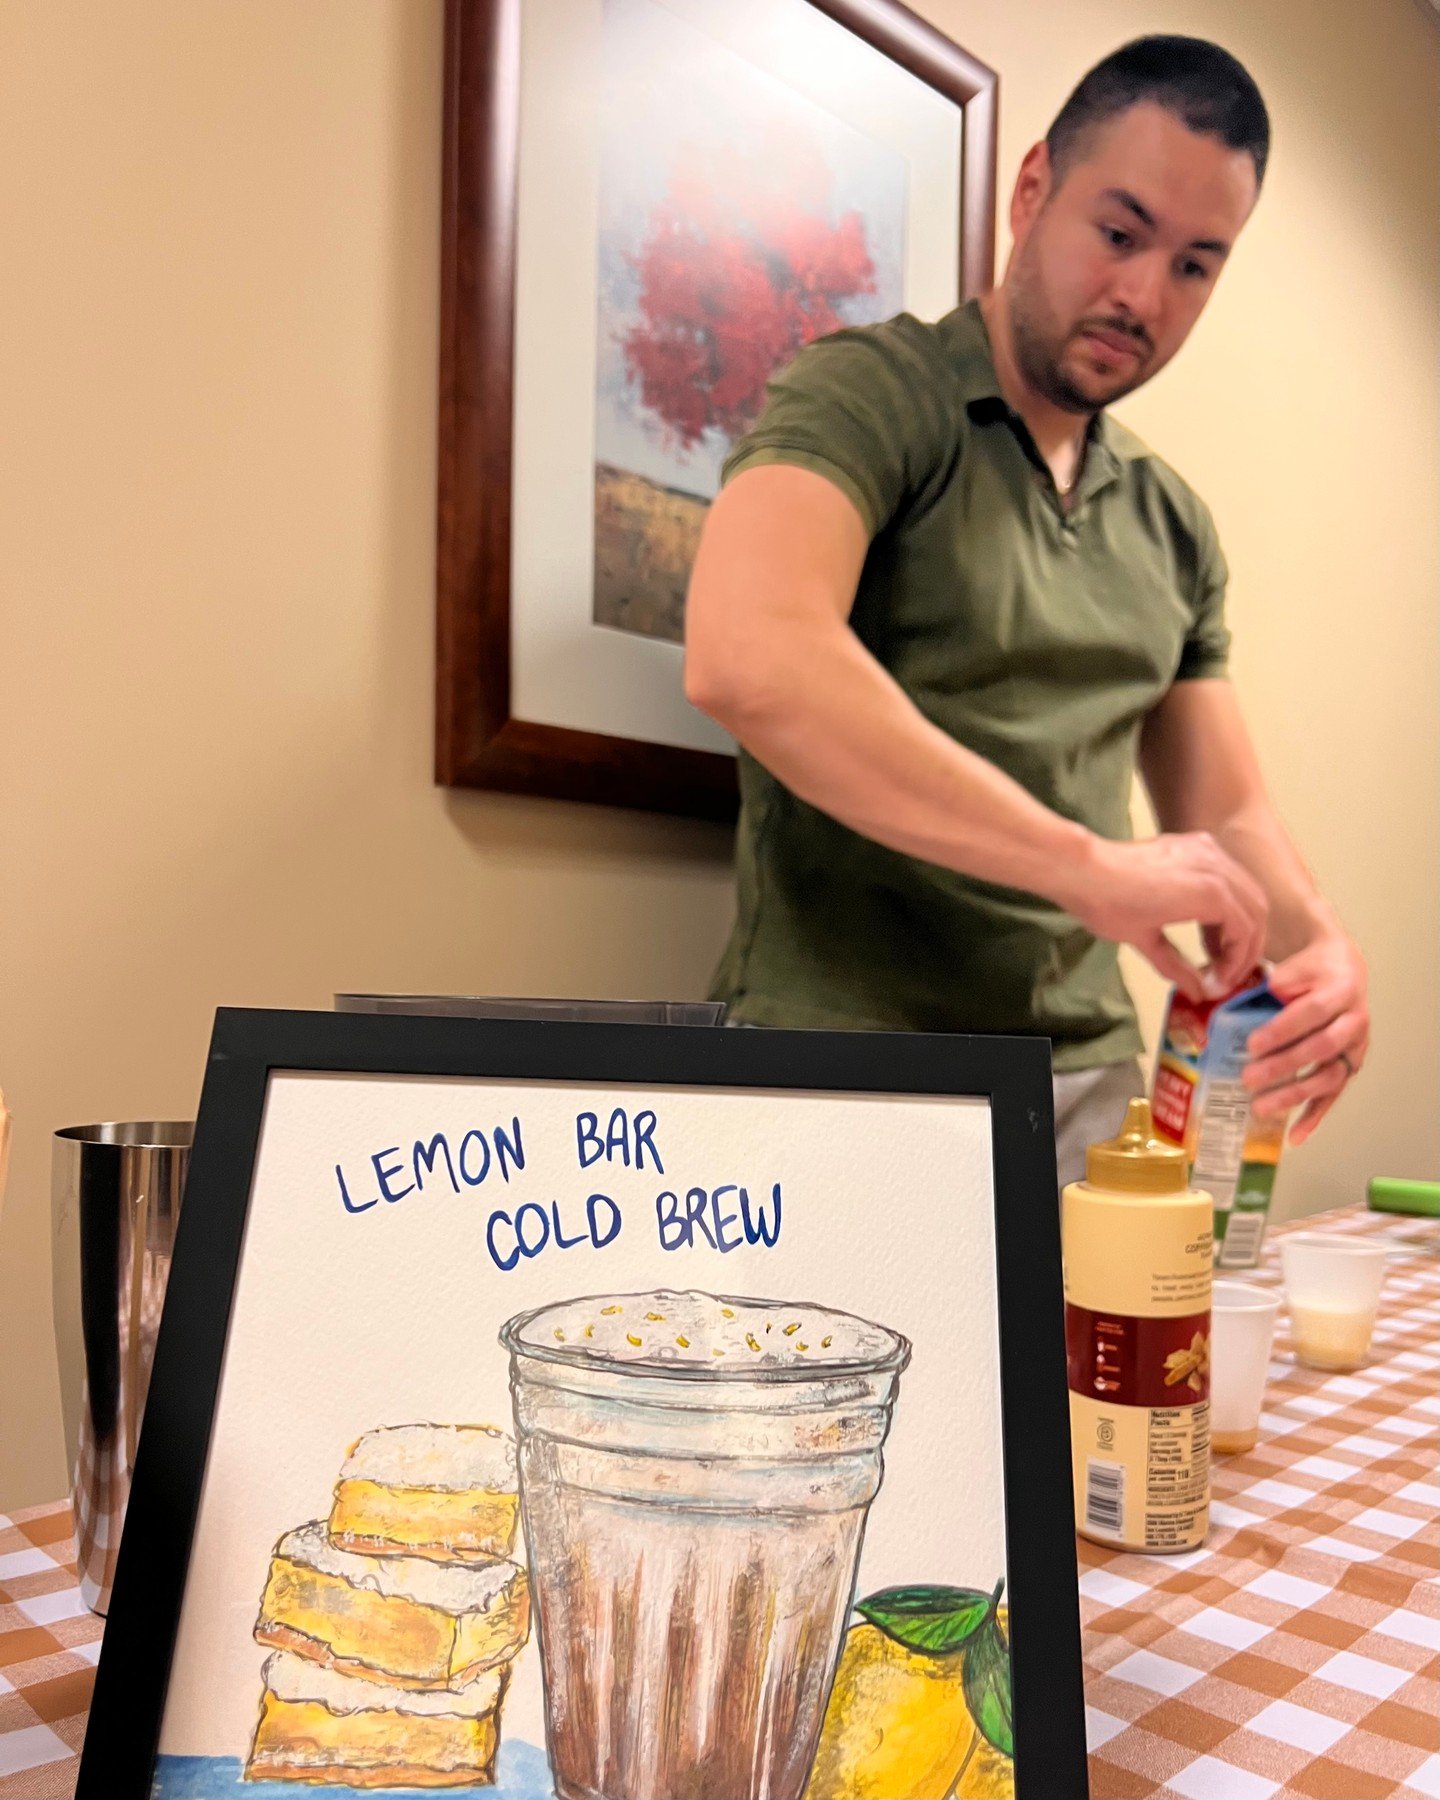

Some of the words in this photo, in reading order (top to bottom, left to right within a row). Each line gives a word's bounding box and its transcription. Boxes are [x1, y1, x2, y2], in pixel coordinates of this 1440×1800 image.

[335, 1117, 525, 1213] LEMON
[576, 1107, 665, 1175] BAR
[486, 1193, 622, 1271] COLD
[656, 1182, 781, 1254] BREW
